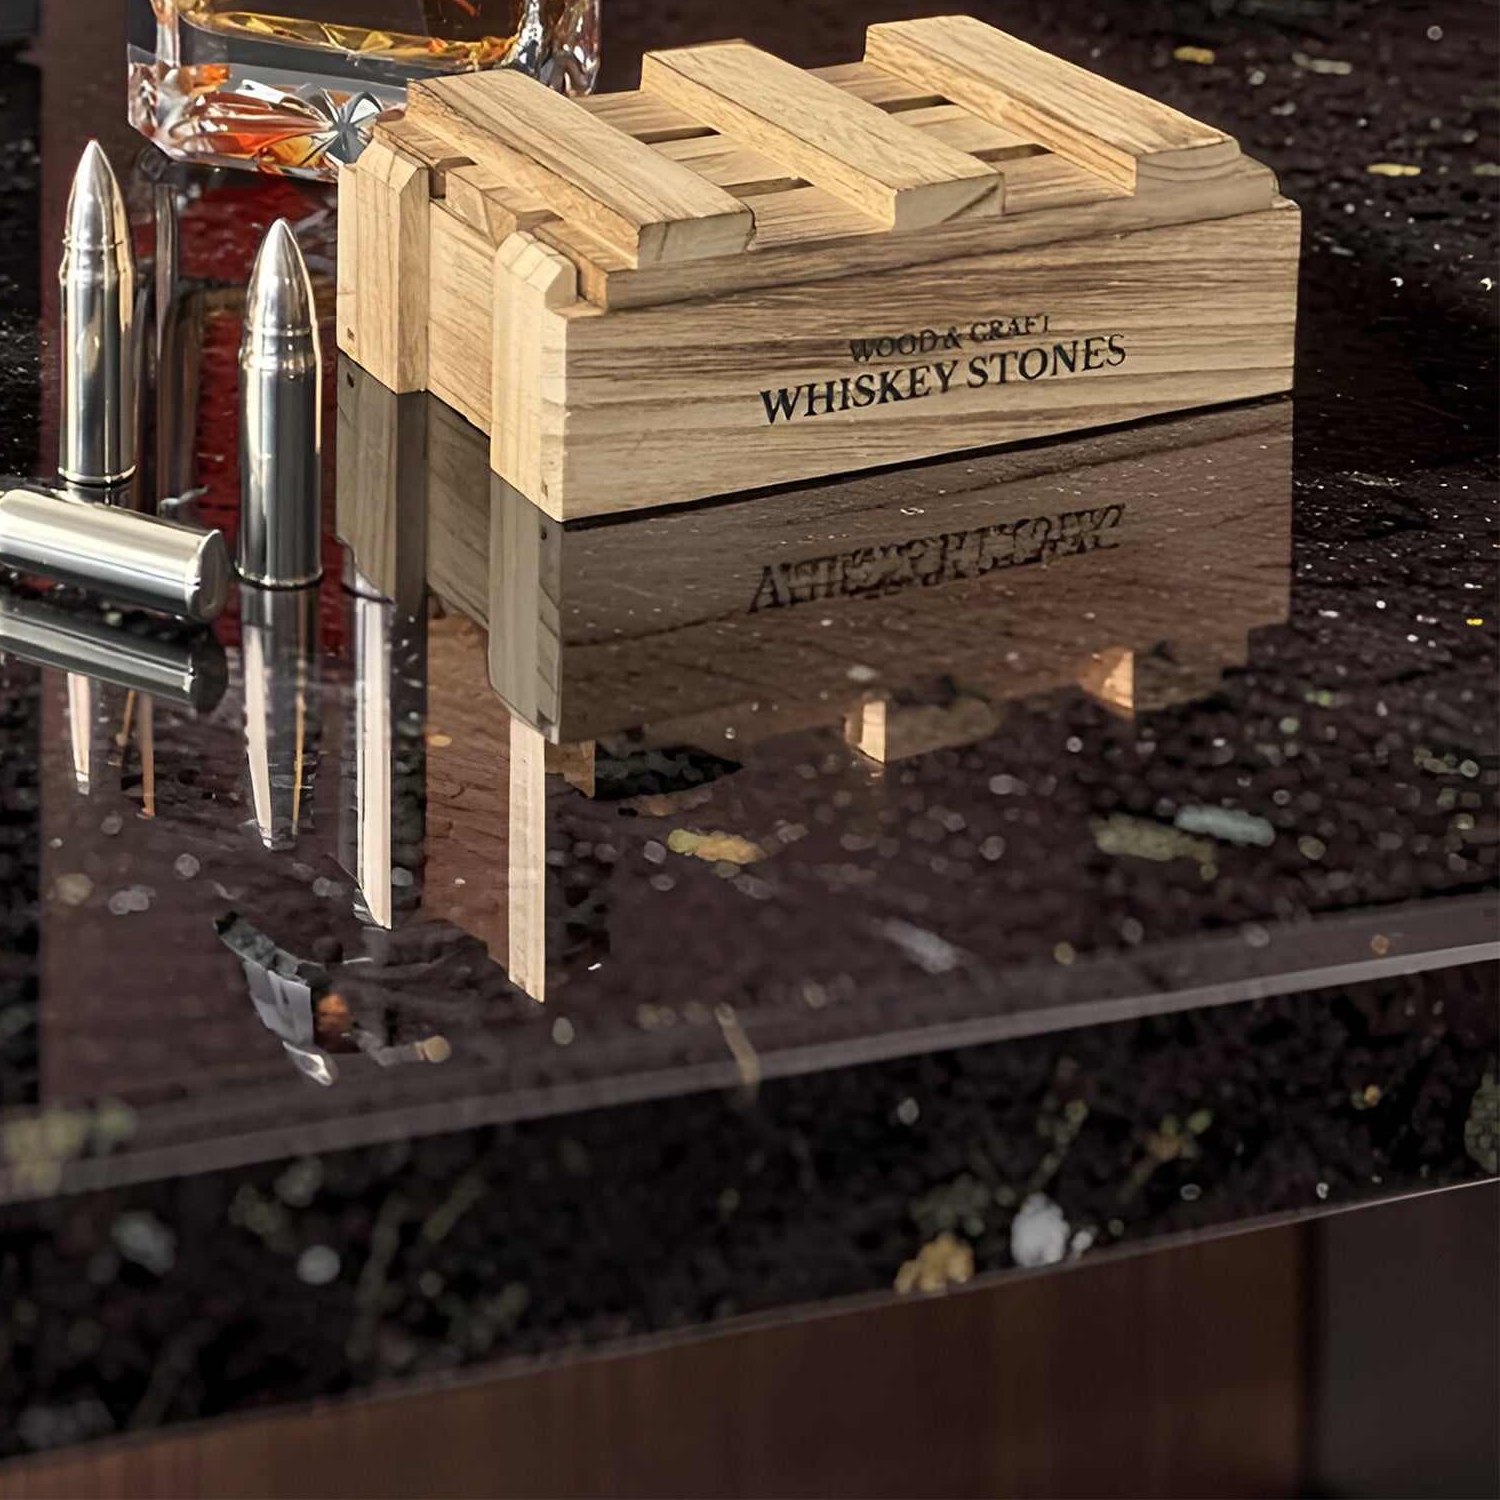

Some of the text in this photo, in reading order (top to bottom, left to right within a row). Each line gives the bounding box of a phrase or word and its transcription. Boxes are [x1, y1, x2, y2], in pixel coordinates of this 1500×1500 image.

[849, 328, 938, 363] WOOD
[759, 333, 1128, 426] WHISKEY STONES
